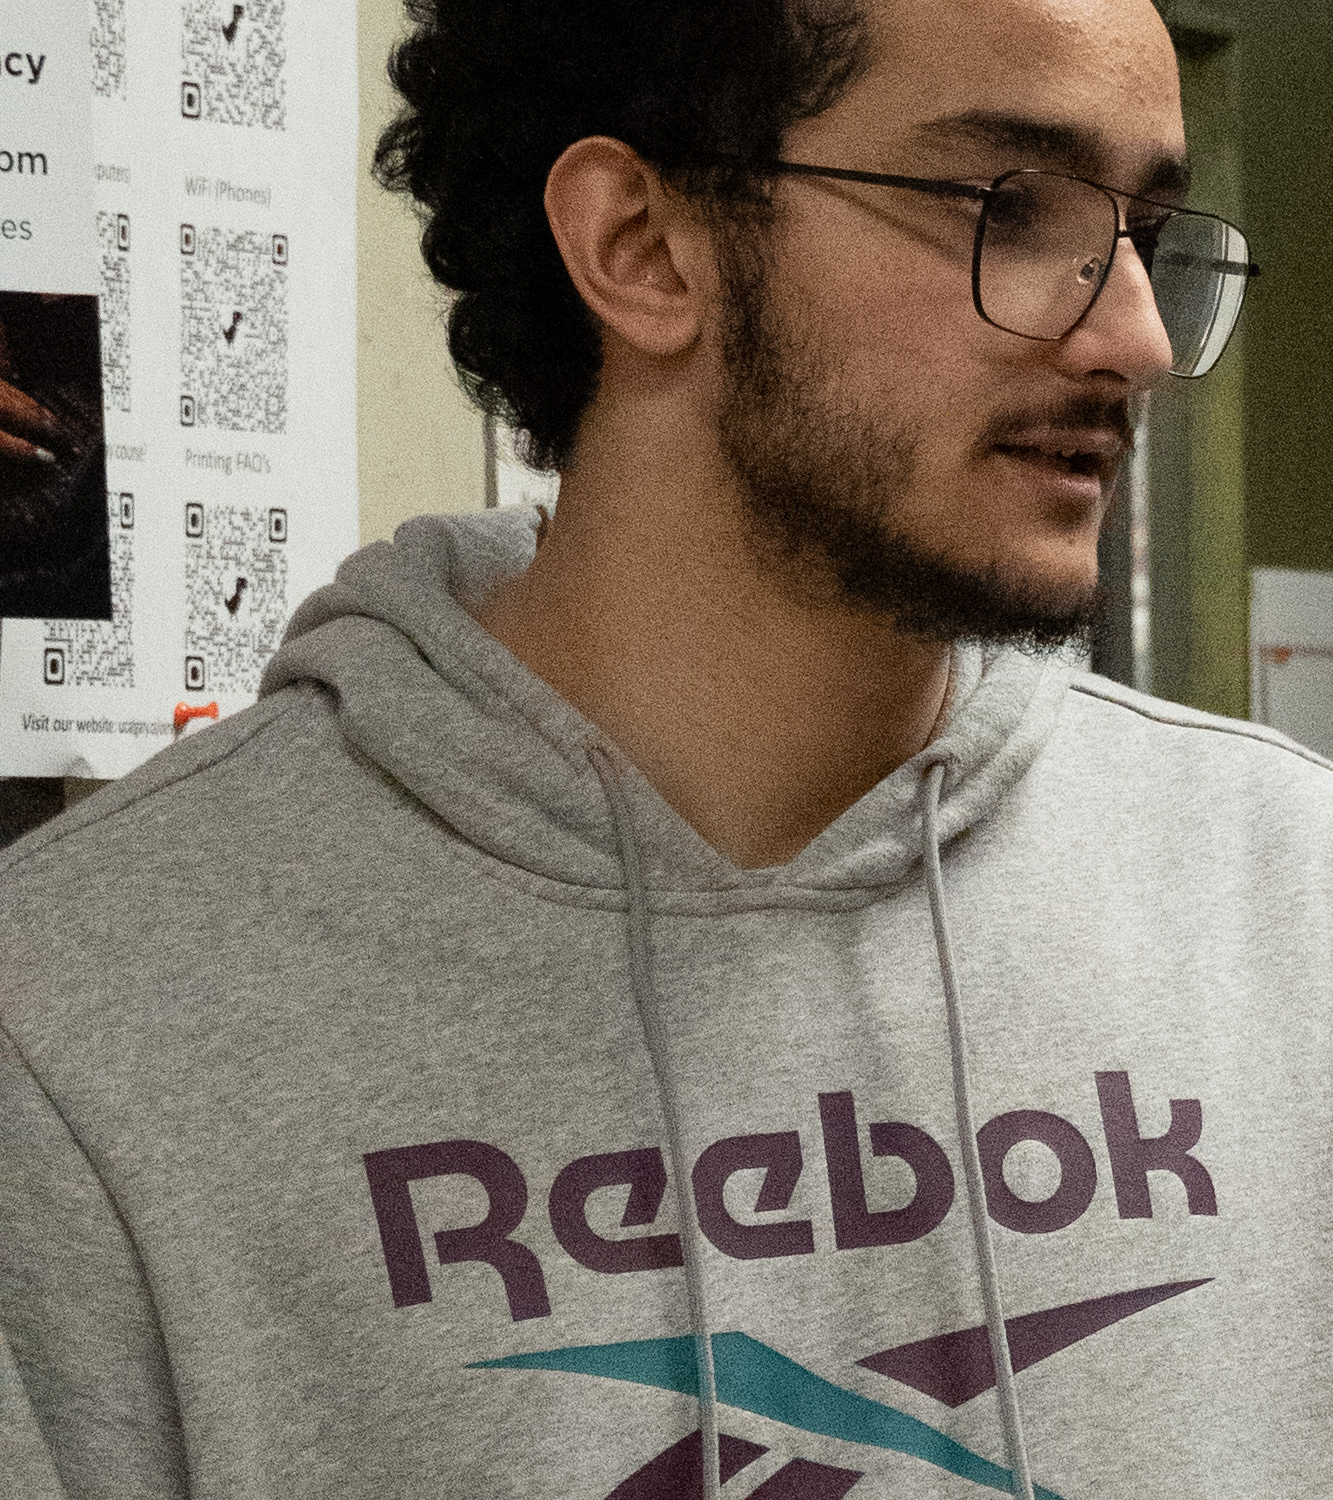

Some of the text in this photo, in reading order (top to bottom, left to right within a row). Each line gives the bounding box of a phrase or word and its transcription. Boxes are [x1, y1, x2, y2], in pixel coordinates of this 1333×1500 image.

[0, 52, 46, 84] cy
[184, 449, 233, 476] Printing
[21, 714, 49, 732] Visit
[53, 717, 73, 733] our
[363, 1071, 1218, 1322] Reebok
